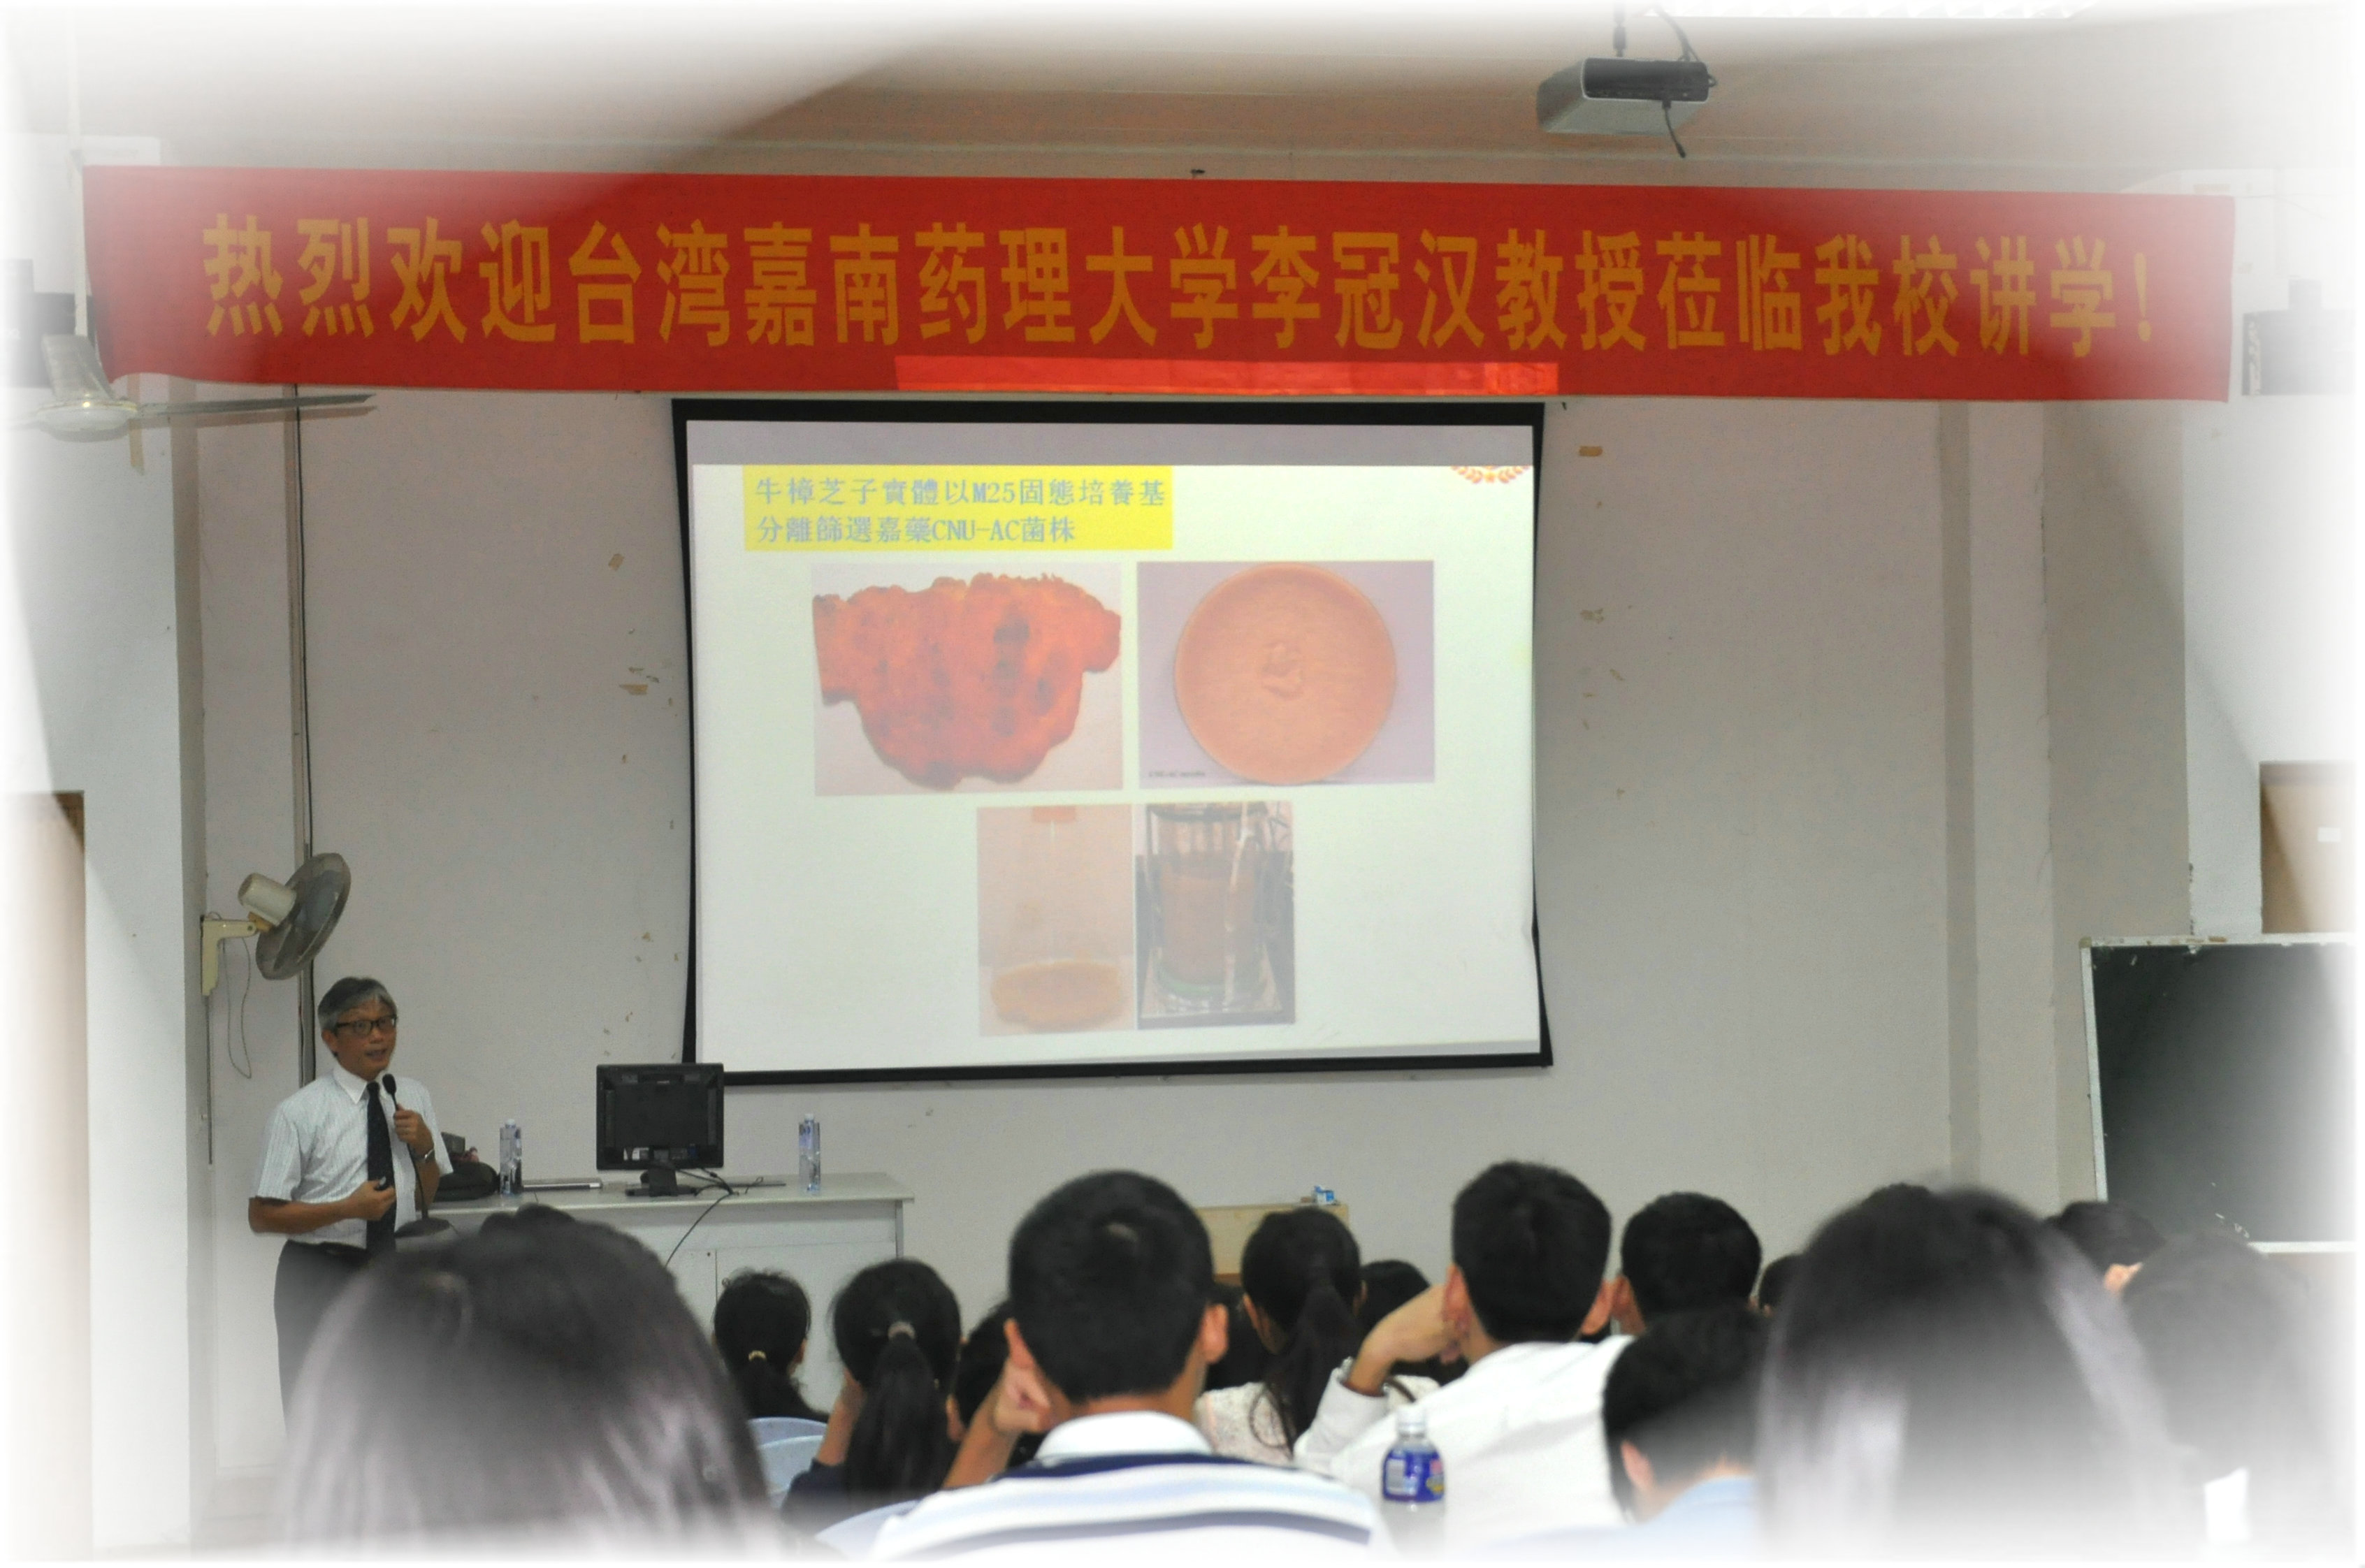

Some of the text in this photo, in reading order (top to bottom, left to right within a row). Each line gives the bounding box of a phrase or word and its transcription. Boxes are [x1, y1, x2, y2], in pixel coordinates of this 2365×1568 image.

[755, 478, 1165, 507] 牛樟芝子實體以M25固態培養基
